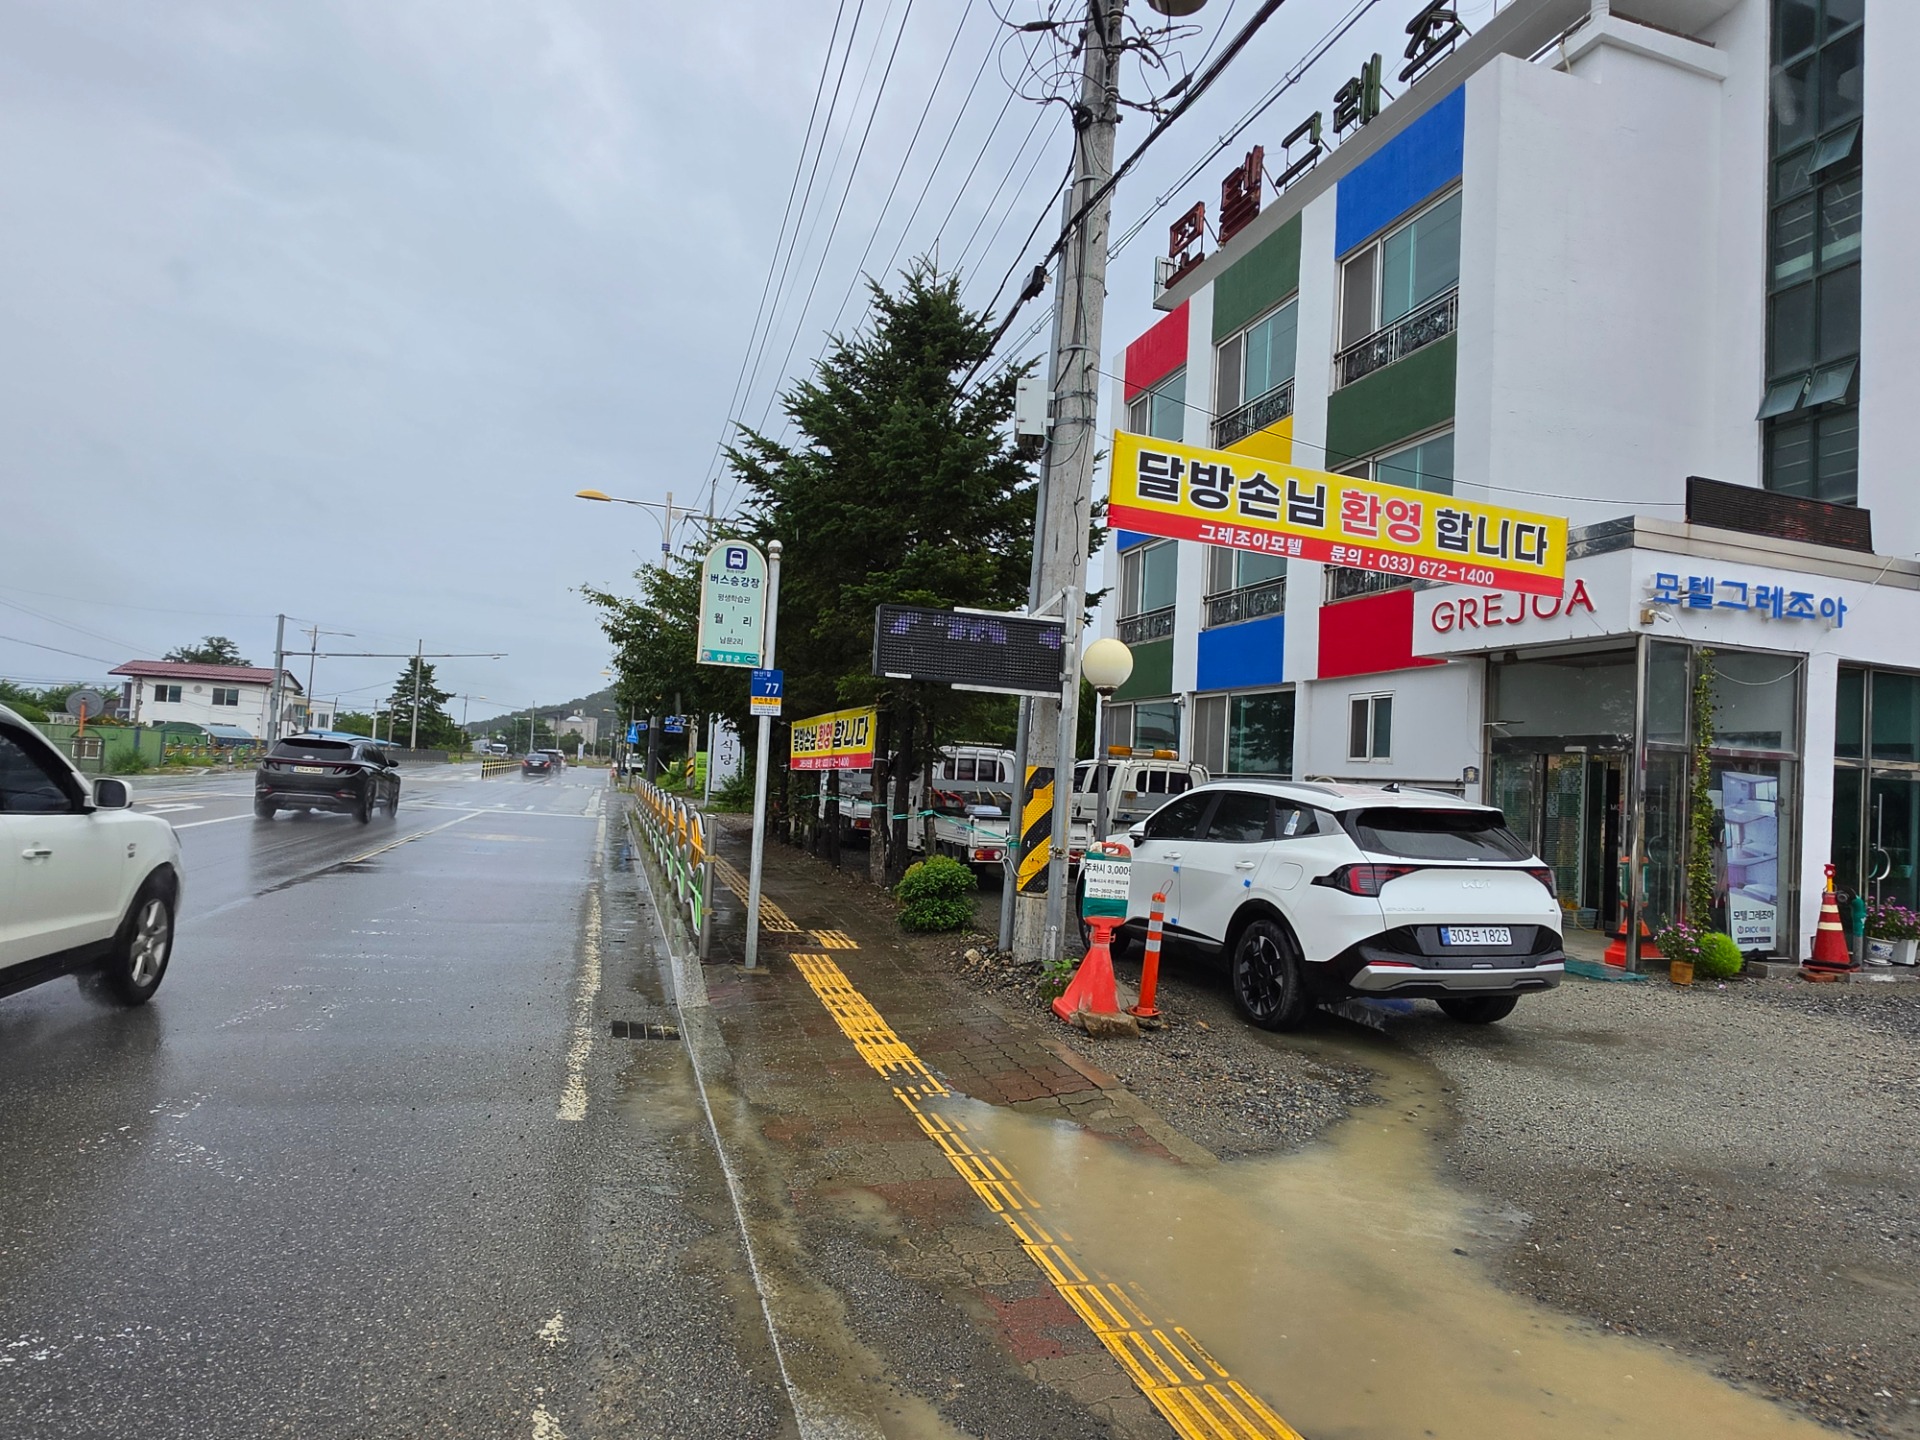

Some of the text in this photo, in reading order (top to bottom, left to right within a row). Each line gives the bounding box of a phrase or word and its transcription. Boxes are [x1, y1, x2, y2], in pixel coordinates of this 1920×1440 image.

[1137, 449, 1549, 566] 달방손님 환영 합니다
[1198, 524, 1303, 557] 그레조아모텔
[1418, 560, 1495, 586] 672-1400
[710, 573, 760, 588] 버스승강장
[1431, 578, 1597, 633] GREJOA
[1654, 572, 1848, 629] 모텔그레조아
[765, 682, 779, 695] 77
[794, 716, 869, 752] 달방손님 환영 합니다
[1085, 862, 1106, 874] 주차시
[1733, 910, 1774, 921] 모텔 그레조아
[1482, 929, 1509, 943] 1823
